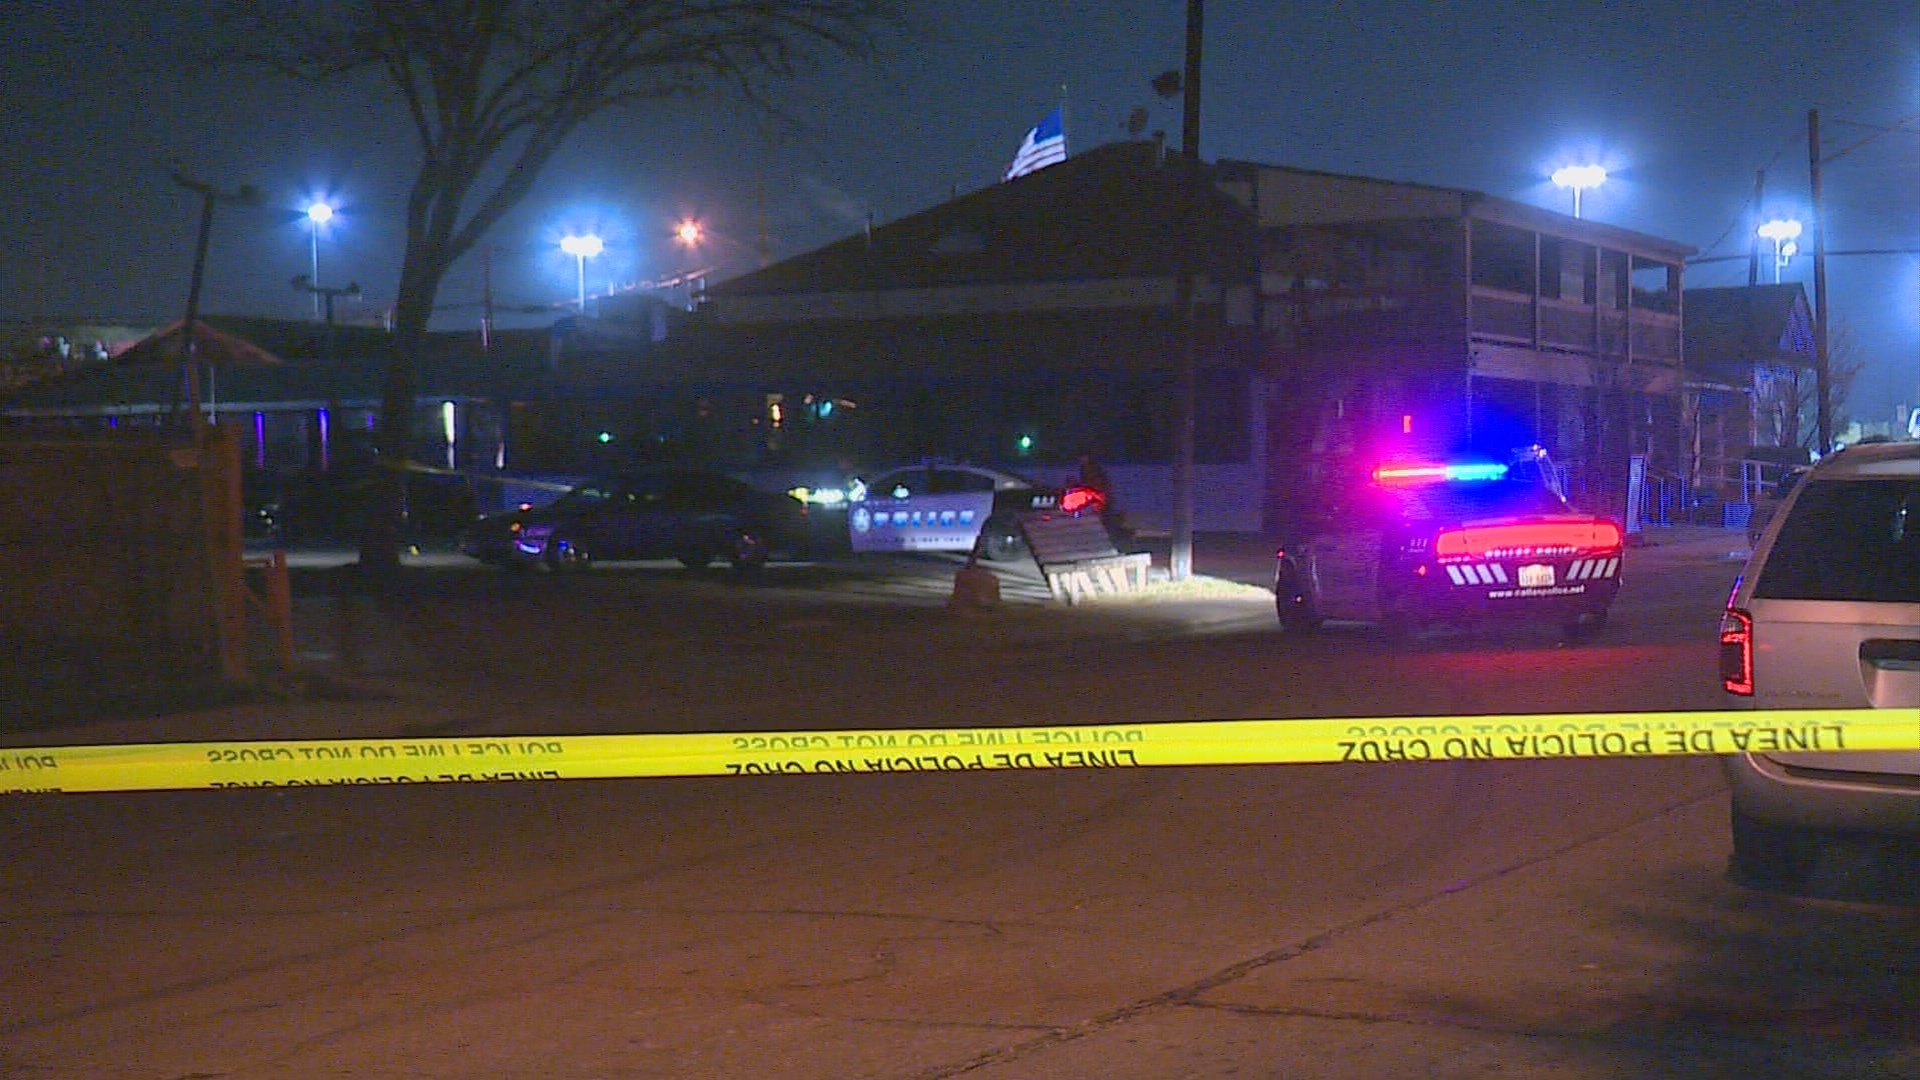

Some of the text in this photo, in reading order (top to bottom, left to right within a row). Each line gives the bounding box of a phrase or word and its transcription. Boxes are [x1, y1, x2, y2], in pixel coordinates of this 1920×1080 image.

[1443, 737, 1494, 758] NO
[1505, 732, 1651, 757] POLICIA
[1665, 730, 1716, 752] DE
[1730, 726, 1846, 750] LINEA
[993, 753, 1036, 769] DE
[1045, 749, 1141, 768] LINEA
[1337, 739, 1432, 762] CRUZ
[814, 759, 856, 774] NO
[864, 755, 985, 772] POLICIA
